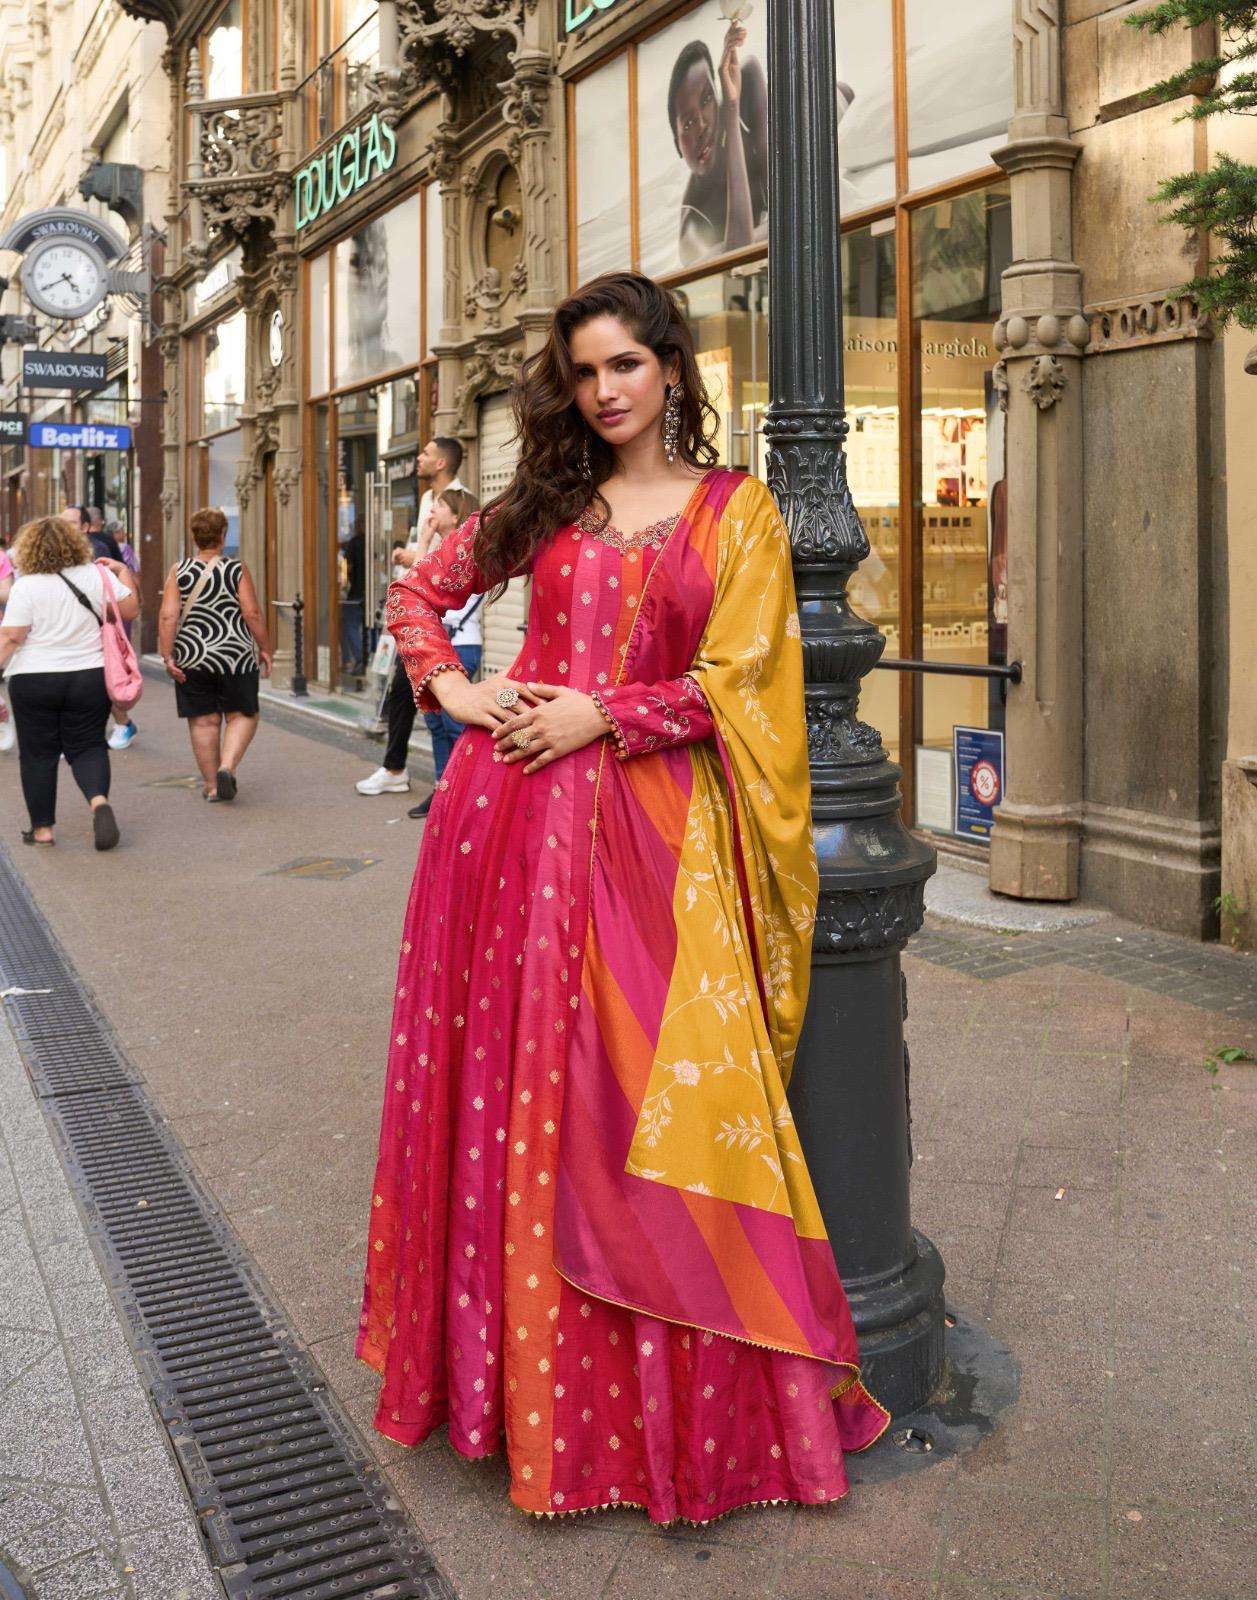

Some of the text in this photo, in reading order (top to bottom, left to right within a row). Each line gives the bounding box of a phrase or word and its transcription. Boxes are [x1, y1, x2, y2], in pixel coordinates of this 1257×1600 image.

[295, 112, 396, 230] DOUGLAS
[32, 222, 100, 243] SWAROVSKI
[845, 334, 988, 358] aison argiela
[25, 362, 104, 378] SWAROVSKI
[41, 427, 118, 447] Berlitz
